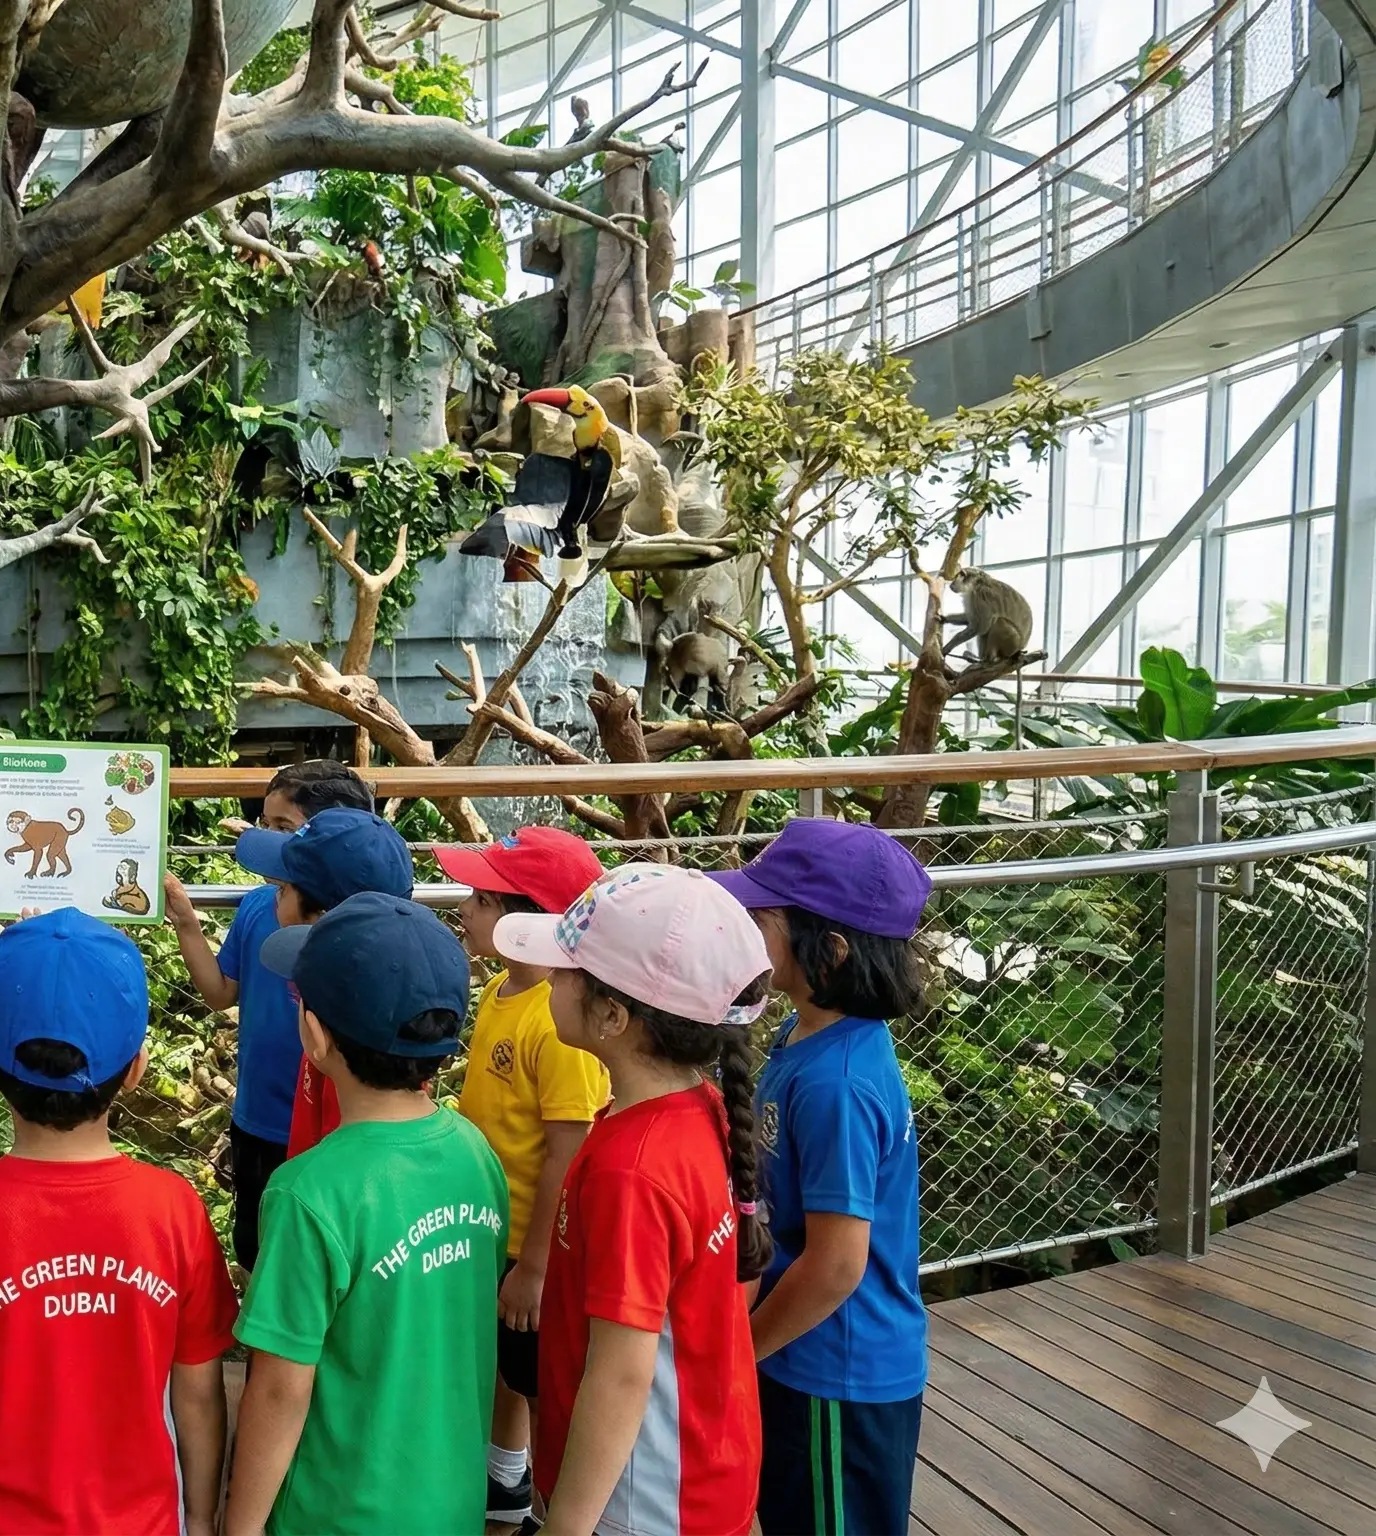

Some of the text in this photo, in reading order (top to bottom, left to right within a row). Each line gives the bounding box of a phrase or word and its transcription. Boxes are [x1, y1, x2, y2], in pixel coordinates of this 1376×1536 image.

[371, 1239, 410, 1280] THE
[408, 1204, 455, 1247] GREEN
[705, 1211, 735, 1255] THE
[422, 1238, 471, 1274] DUBAI
[21, 1254, 96, 1290] GREEN
[102, 1256, 178, 1308] PLANET
[44, 1292, 116, 1318] DUBAI
